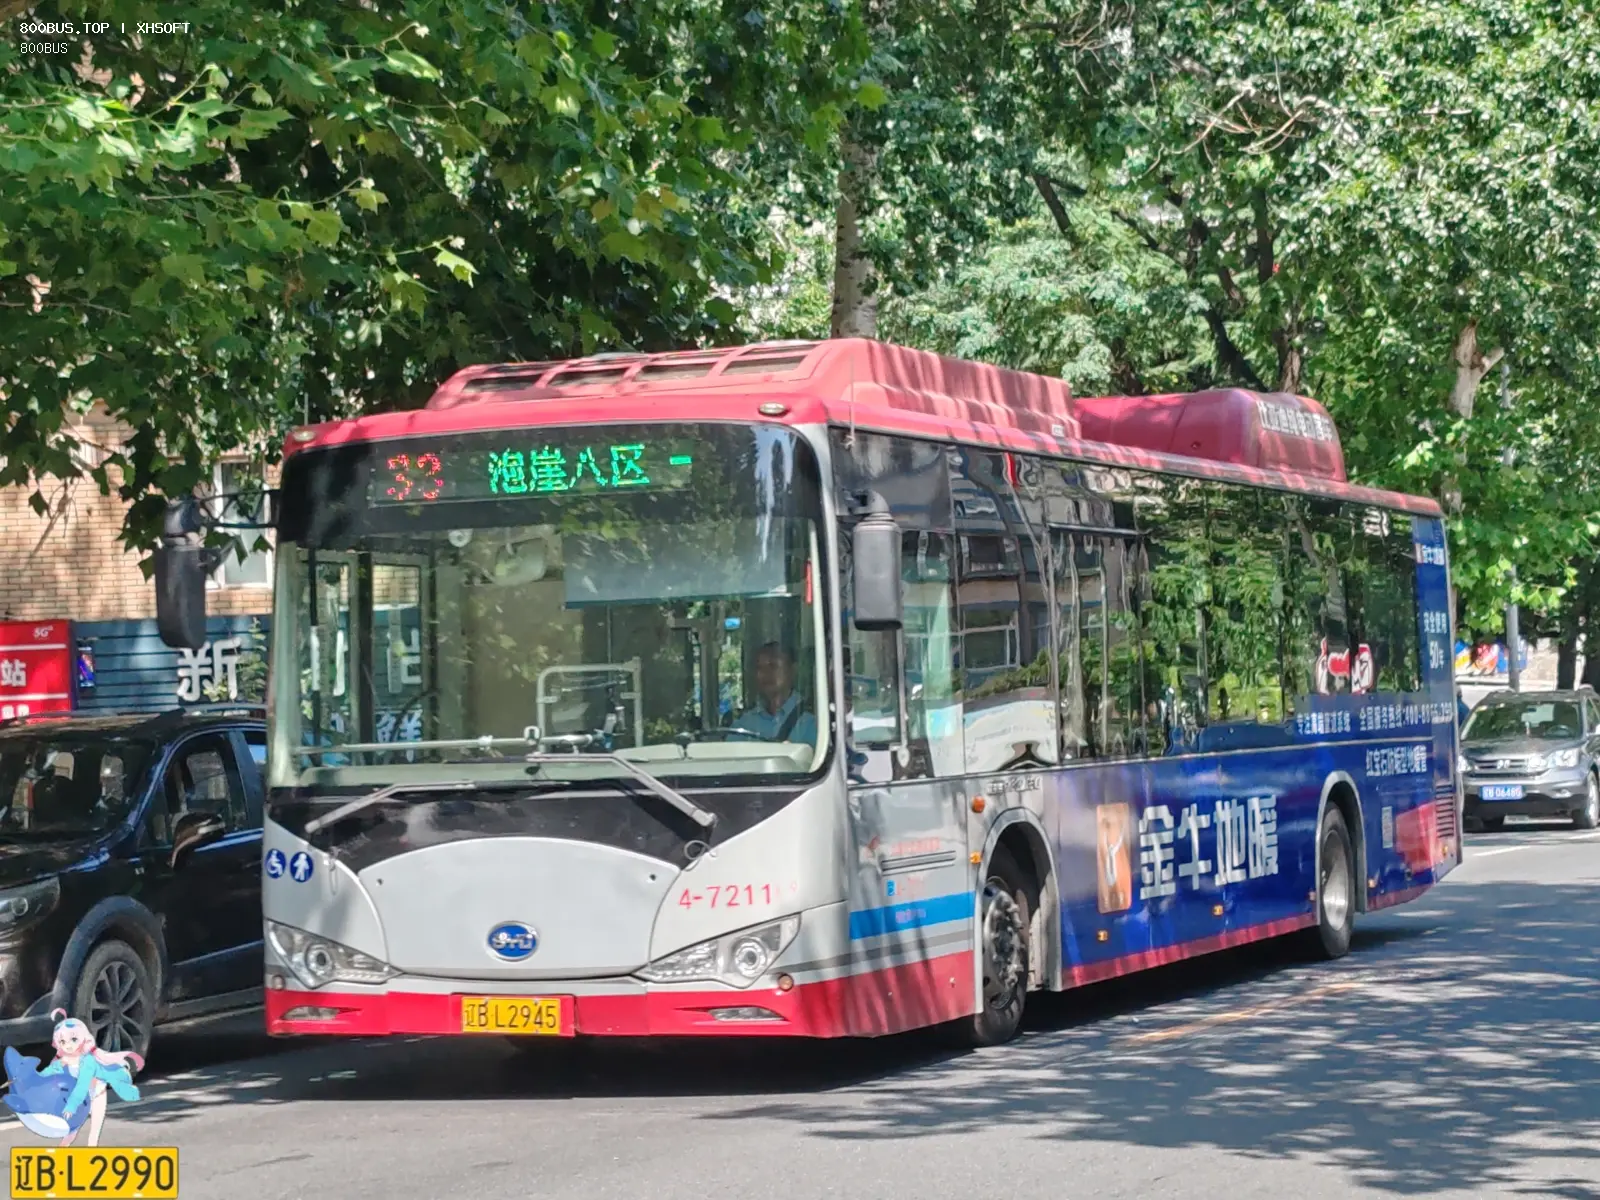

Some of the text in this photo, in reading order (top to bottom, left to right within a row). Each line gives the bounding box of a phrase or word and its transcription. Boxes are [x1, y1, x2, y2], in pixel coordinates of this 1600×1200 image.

[488, 445, 650, 494] 泡崖八区
[0, 658, 27, 688] 站
[177, 637, 242, 702] 新
[1139, 794, 1279, 901] 金牛地暖
[677, 883, 772, 910] 4-7211
